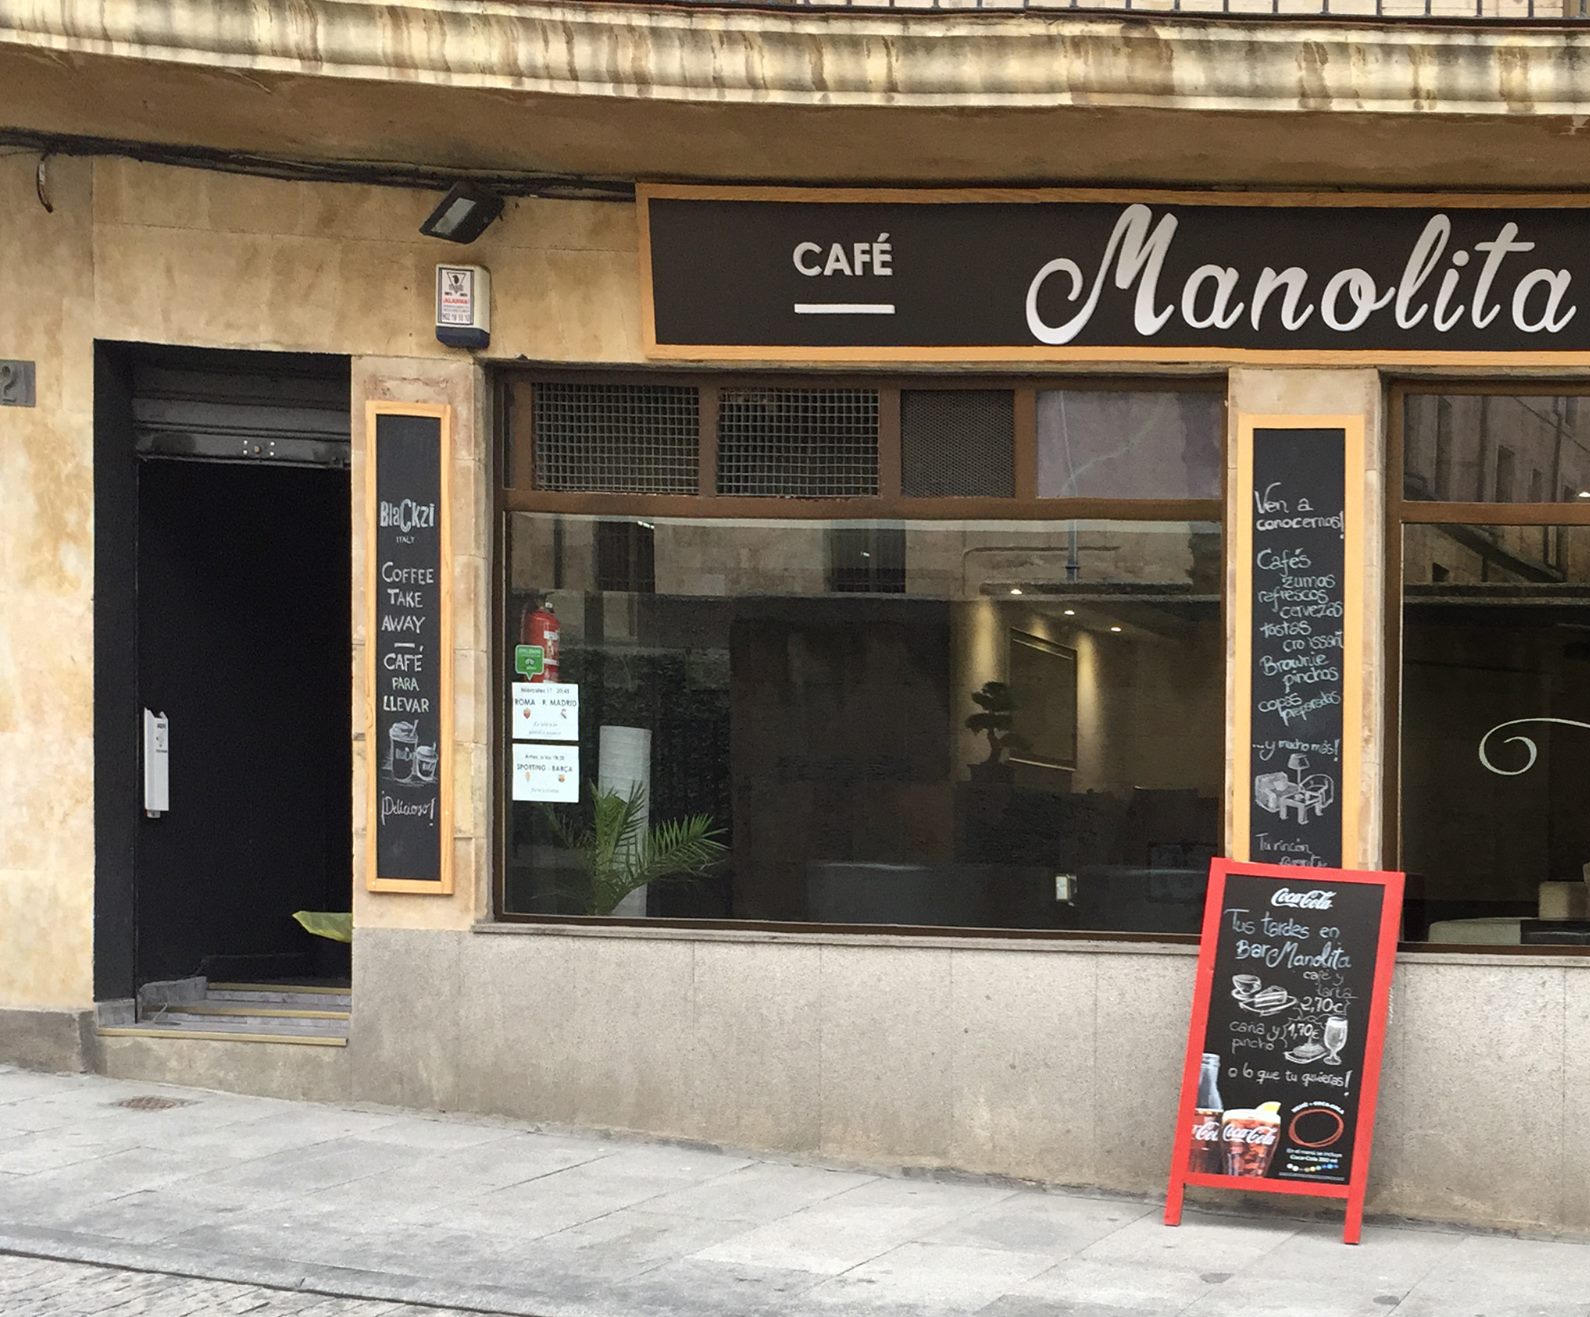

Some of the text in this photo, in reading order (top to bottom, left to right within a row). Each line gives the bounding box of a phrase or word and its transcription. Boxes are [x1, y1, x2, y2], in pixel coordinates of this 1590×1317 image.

[792, 232, 895, 277] CAFÉ
[1026, 203, 1577, 345] Manolita
[1254, 481, 1314, 514] Ven a
[1256, 510, 1344, 540] conocernos!
[396, 535, 415, 544] ITALY
[382, 561, 434, 585] COFFEE
[1256, 547, 1312, 578] Cafés
[1281, 573, 1336, 589] zumos
[387, 588, 423, 608] TAKE
[1258, 585, 1329, 613] refrescos
[1280, 600, 1344, 619] cervezas
[381, 614, 426, 634] AWAY
[383, 645, 424, 672] CAFÉ
[1259, 651, 1330, 676] Brownie
[391, 676, 420, 692] PARA
[1282, 666, 1340, 694] pinchos
[383, 695, 430, 713] LLEVAR
[514, 698, 535, 706] ROMA
[550, 699, 577, 707] MADRID
[1258, 692, 1302, 717] copas
[1256, 832, 1271, 851] Tu
[1271, 887, 1337, 910] Coca-Cola
[1223, 908, 1340, 939] Tus tardes en
[1235, 939, 1352, 970] Bar Manolita
[1231, 1037, 1275, 1055] pincho
[1228, 1067, 1238, 1078] o
[1256, 1069, 1281, 1085] que
[1285, 1070, 1298, 1082] tu
[1222, 1123, 1279, 1146] Coca-Cola
